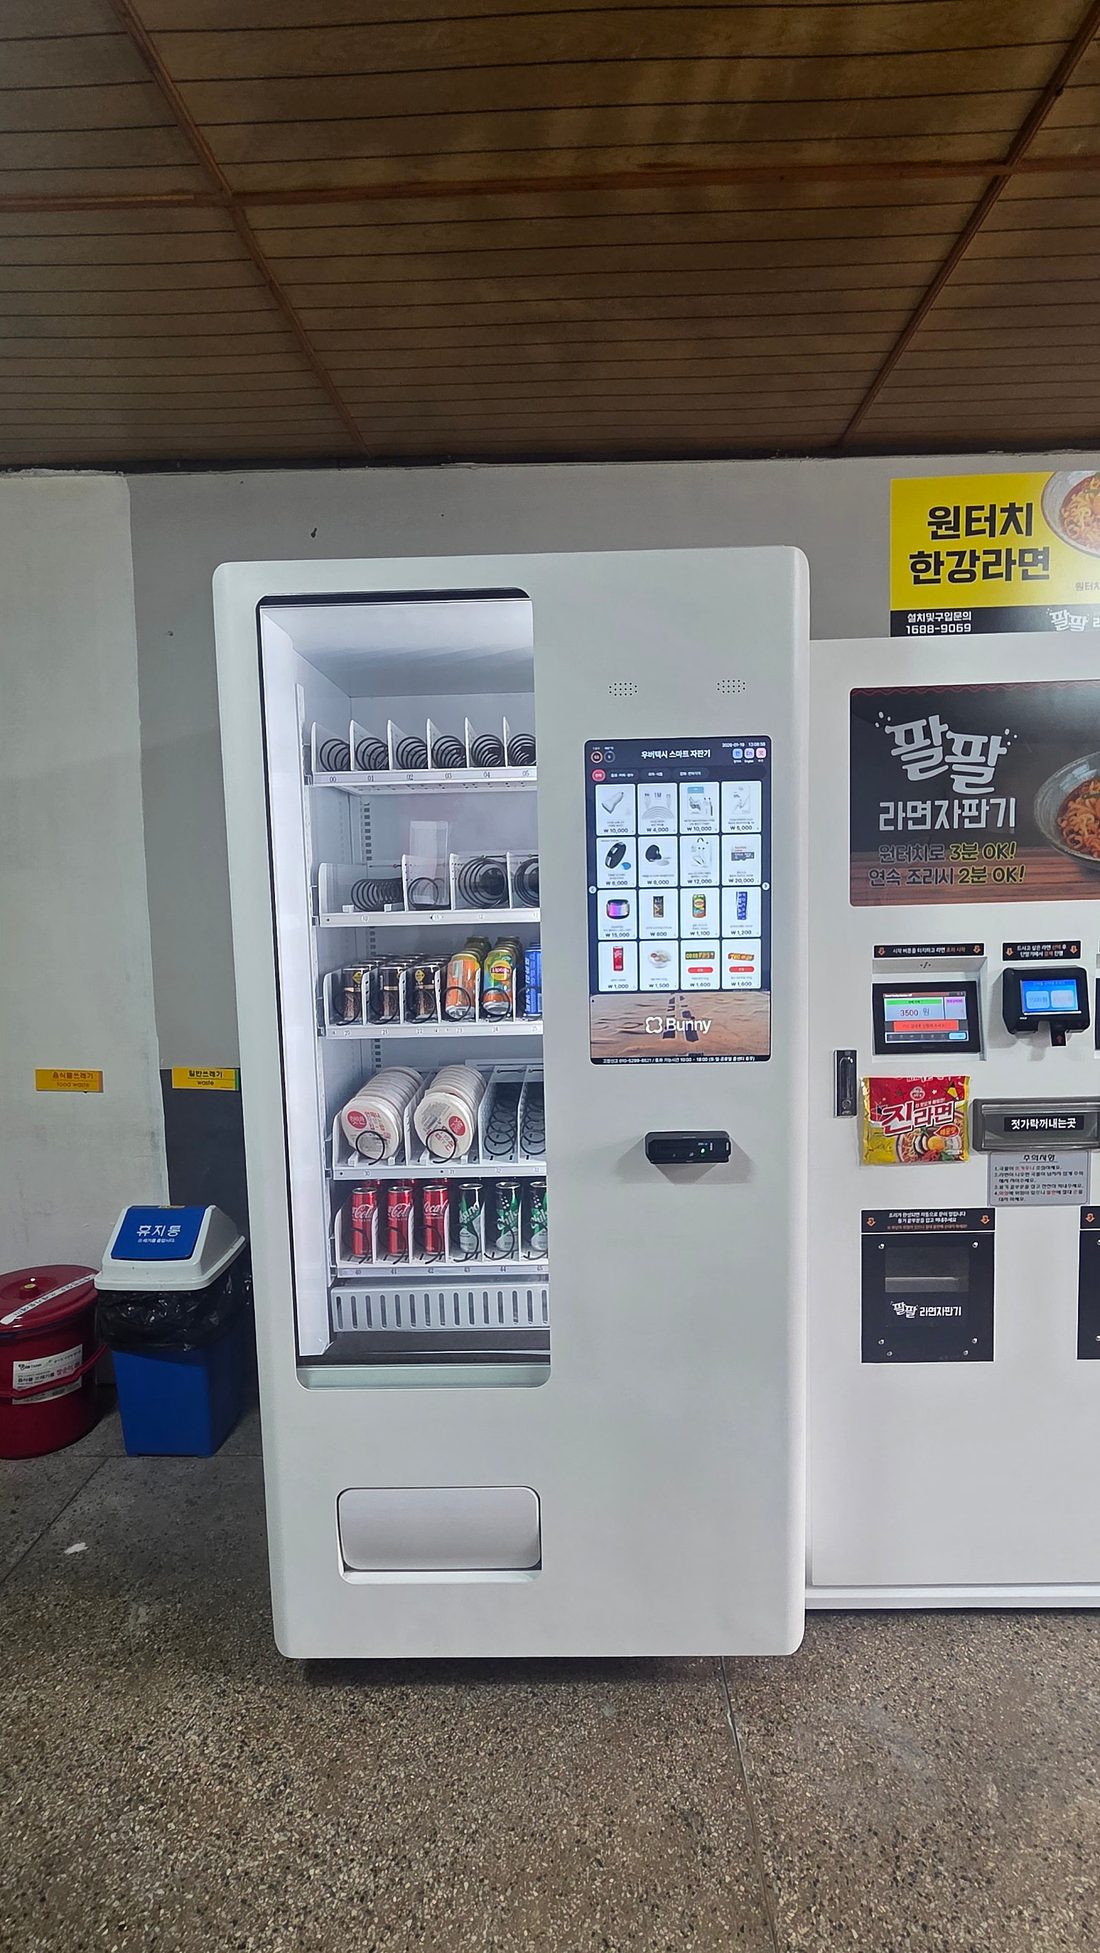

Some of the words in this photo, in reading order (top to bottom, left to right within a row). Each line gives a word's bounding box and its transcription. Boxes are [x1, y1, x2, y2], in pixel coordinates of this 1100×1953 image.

[927, 502, 1034, 540] 원터치
[909, 547, 1050, 585] 한강라면
[907, 610, 972, 622] 설치및구입문의
[905, 623, 972, 635] 1688-9069
[669, 750, 689, 758] 스마트
[690, 749, 711, 758] 자판기
[884, 714, 1008, 795] 팔팔
[879, 797, 1016, 831] 라면자판기
[878, 844, 945, 864] 원터치로
[949, 842, 978, 861] 3분
[982, 841, 1017, 861] OK!
[869, 869, 901, 887] 연속
[906, 868, 954, 885] 조리시
[958, 866, 987, 884] 2분
[992, 865, 1026, 884] OK!
[900, 1009, 919, 1017] 3500
[922, 1008, 930, 1016] 원
[666, 1018, 711, 1034] Bunny
[881, 1101, 954, 1135] 진라면
[1011, 1117, 1077, 1130] 젓가락꺼내는곳
[1023, 1153, 1056, 1162] 주의사항
[136, 1224, 182, 1237] 휴지통
[919, 1306, 962, 1317] 라면자판기
